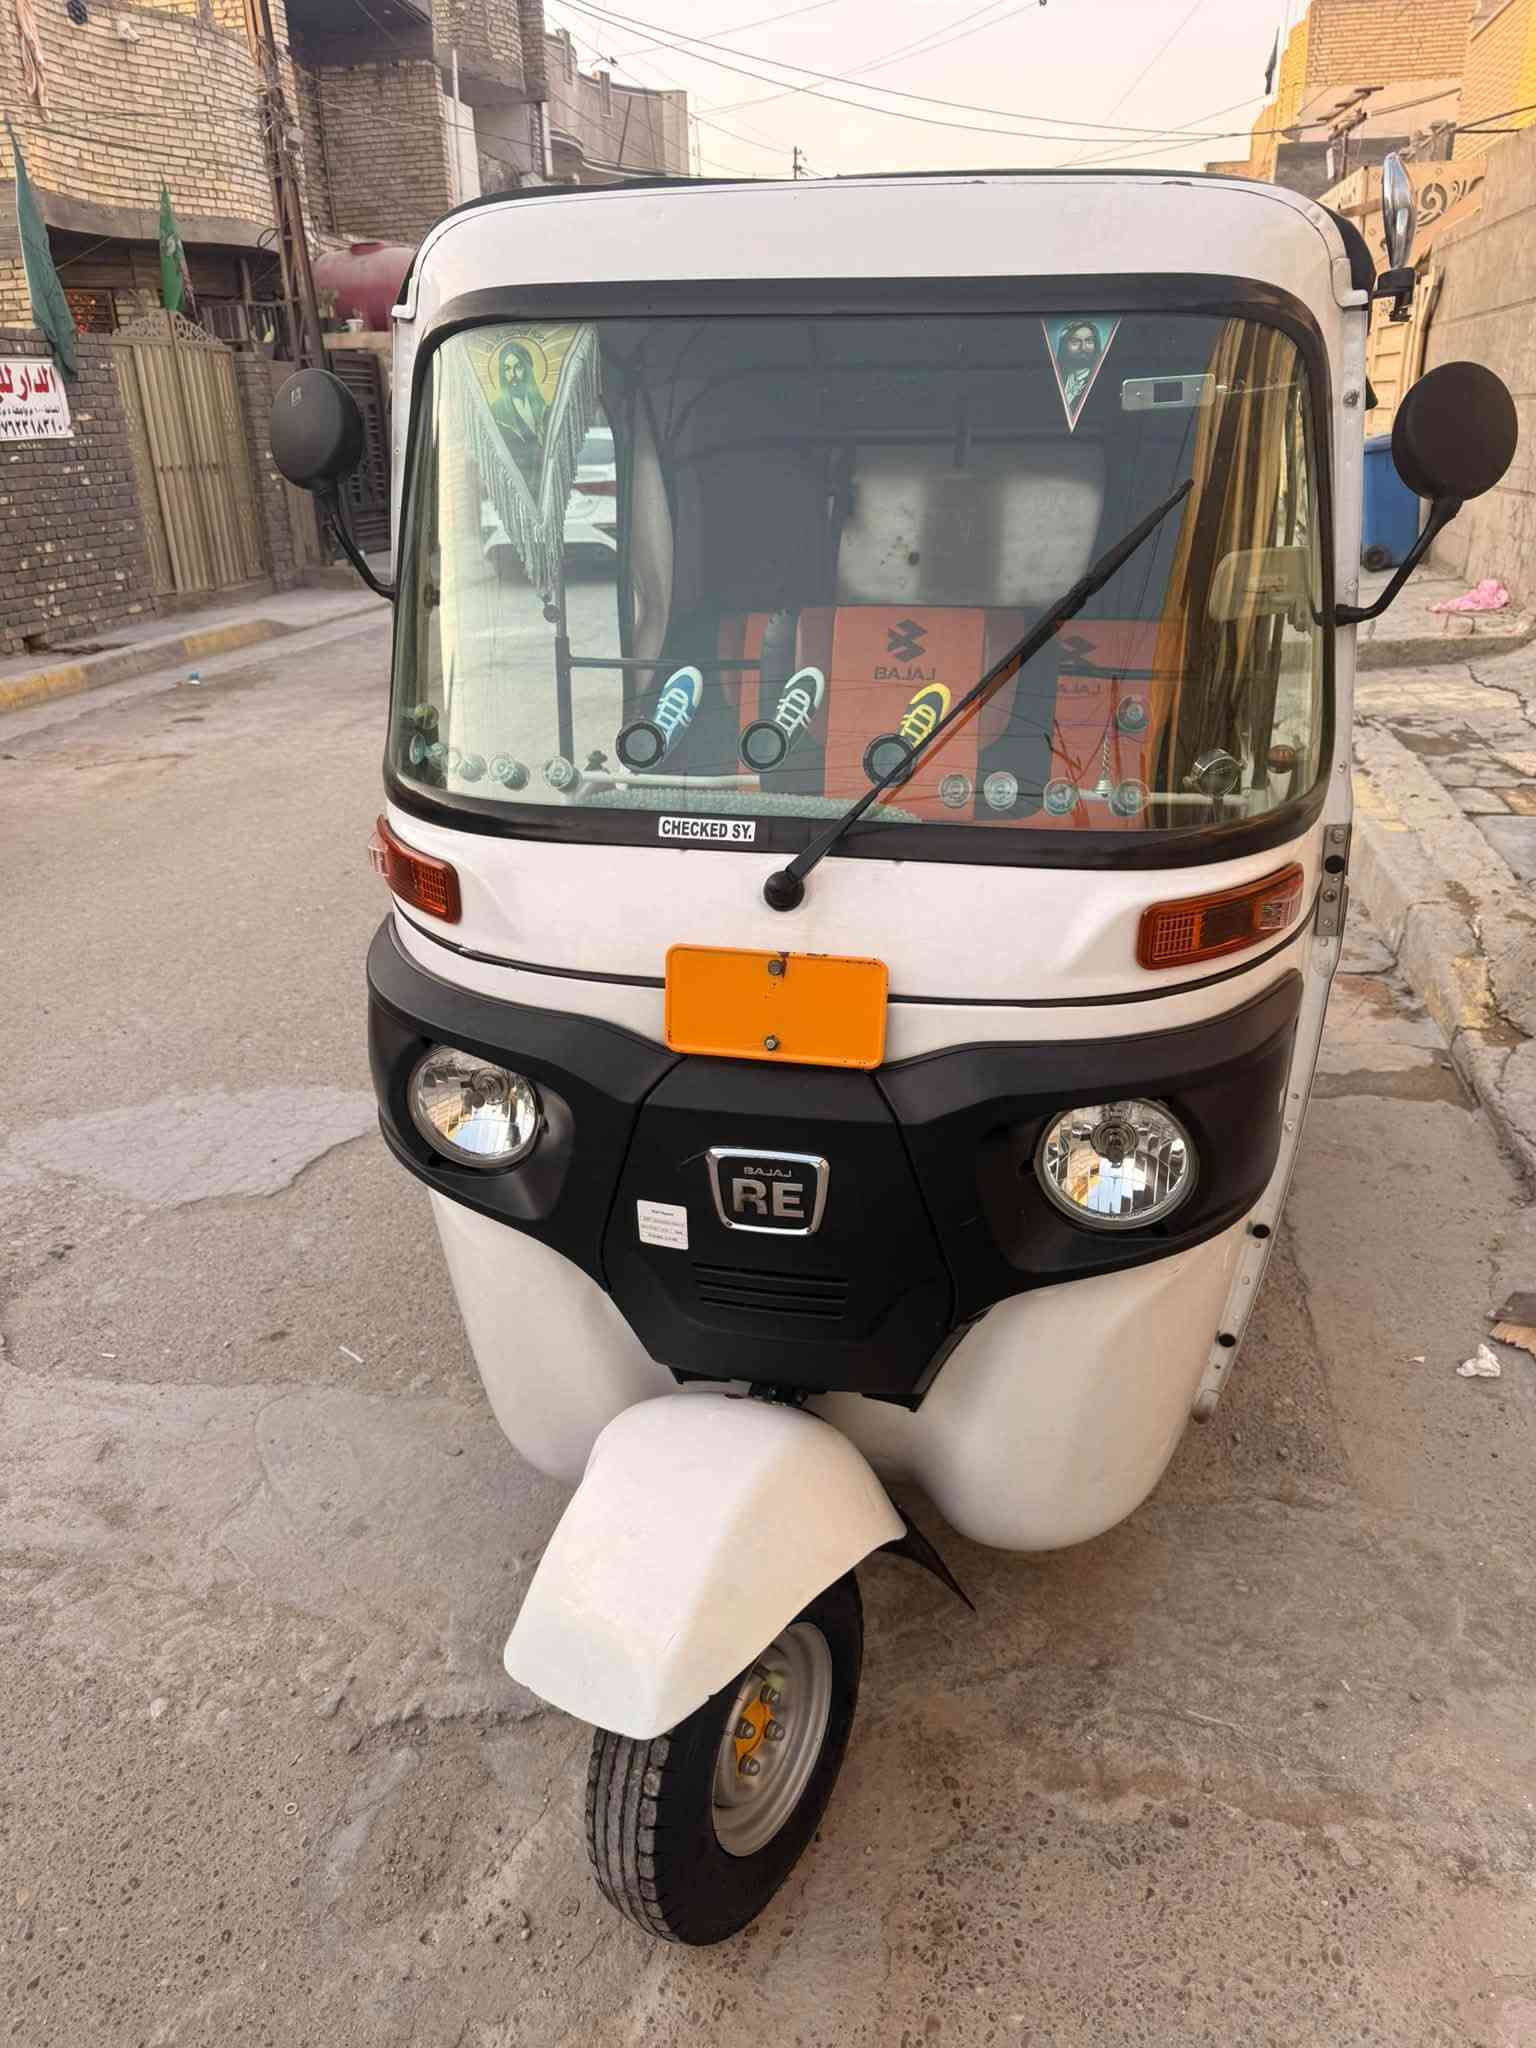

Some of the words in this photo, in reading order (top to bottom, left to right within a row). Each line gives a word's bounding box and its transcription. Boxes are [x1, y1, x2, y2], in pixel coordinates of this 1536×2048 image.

[17, 365, 56, 401] الدار
[875, 666, 937, 681] BAJAJ
[1056, 682, 1102, 696] AJAJ
[662, 820, 728, 838] CHECKED
[732, 823, 752, 840] SY.
[743, 1166, 792, 1178] BAJAJ
[731, 1177, 805, 1218] RE
